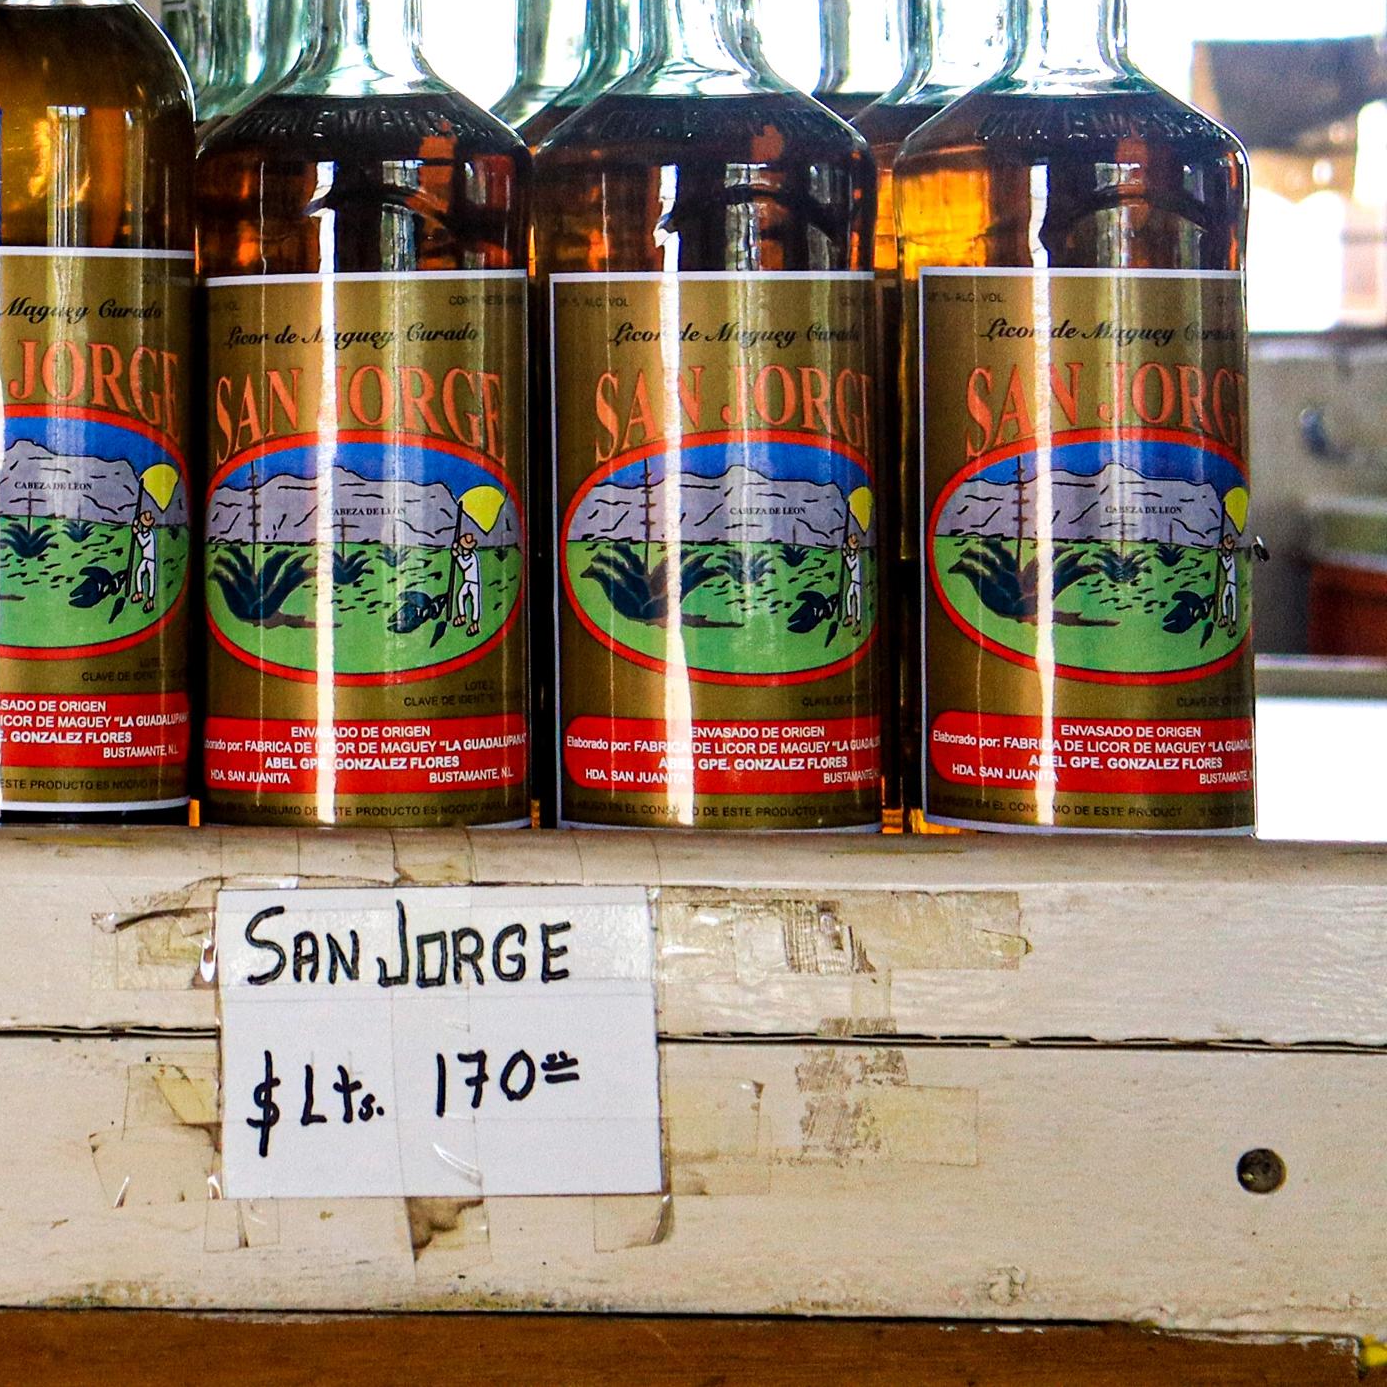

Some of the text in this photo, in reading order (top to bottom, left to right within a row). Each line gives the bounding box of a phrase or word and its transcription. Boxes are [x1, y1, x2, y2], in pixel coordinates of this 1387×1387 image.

[0, 297, 89, 324] Maguey
[226, 324, 269, 346] Licor
[275, 326, 299, 344] de
[407, 322, 478, 342] Curado
[706, 322, 796, 348] Maguey
[1051, 319, 1078, 339] de
[1082, 321, 1174, 346] Maguey
[8, 339, 179, 439] JORGE
[216, 367, 303, 464] SAN
[39, 700, 55, 712] DE
[60, 700, 106, 712] ORIGEN
[11, 731, 82, 744] GONZALEZ
[85, 731, 132, 744] FLORES
[361, 726, 378, 738] DE
[382, 726, 430, 737] ORIGEN
[691, 726, 825, 738] ENVASADO DE ORIGEN
[1061, 725, 1201, 738] ENVASADO DE ORIGEN
[933, 730, 976, 746] Elaborado
[979, 734, 1000, 747] por:
[1064, 741, 1083, 751] DE
[1087, 741, 1129, 753] LICOR
[1133, 742, 1150, 753] DE
[1155, 741, 1206, 754] MAGUEY
[265, 757, 296, 770] ABEL
[335, 757, 407, 770] GONZALEZ
[410, 756, 459, 768] FLORES
[699, 758, 730, 770] GPE.
[734, 758, 804, 770] GONZALEZ
[807, 756, 847, 768] FLORES
[1070, 756, 1103, 769] GPE.
[1107, 757, 1179, 770] GONZALEZ
[1182, 757, 1222, 770] FLORES
[952, 764, 976, 776] HDA.
[979, 766, 1002, 778] SAN
[245, 899, 573, 988] SAN JORGE
